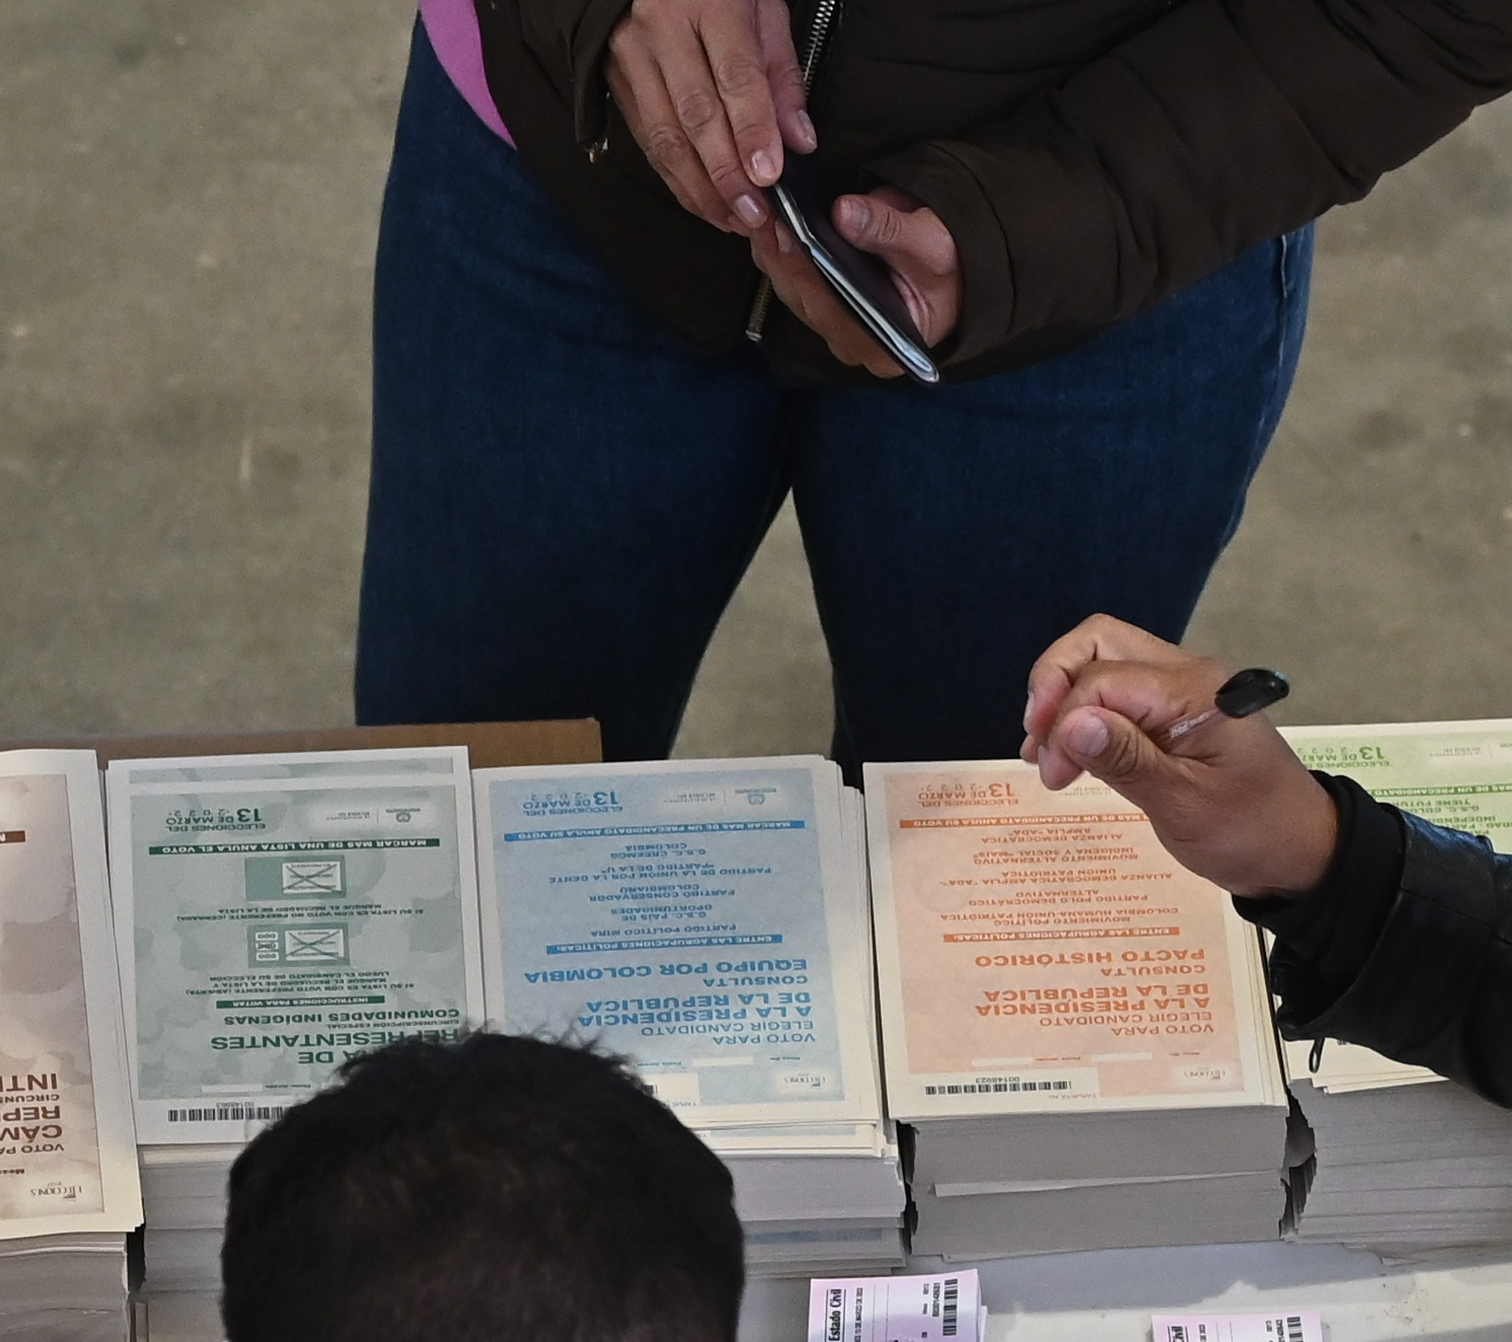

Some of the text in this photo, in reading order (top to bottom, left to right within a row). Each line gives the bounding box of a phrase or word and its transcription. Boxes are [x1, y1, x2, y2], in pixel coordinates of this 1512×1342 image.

[1357, 747, 1385, 760] 13
[989, 783, 1014, 798] 13
[594, 792, 618, 806] 13
[237, 809, 262, 823] 13
[975, 949, 1205, 967] PACTO HISTÓRICO
[525, 959, 807, 983] EQUIPO POR COLOMBIA
[1101, 966, 1206, 976] CONSULTA
[703, 976, 808, 987] CONSULTA
[984, 984, 1209, 1002] DE LA REPÚBLICA
[586, 993, 810, 1013] DE LA REPÚBLICA
[976, 998, 1210, 1017] A LA PRESIDENCIA
[225, 1010, 460, 1026] COMUNIDADES INDÍGENAS
[575, 1007, 811, 1027] A LA PRESIDENCIA
[1040, 1012, 1212, 1027] ELEGIR CANDIDATO
[639, 1021, 814, 1037] ELEGIR CANDIDATO
[1111, 1024, 1214, 1036] VOTO PARA
[713, 1034, 816, 1045] VOTO PARA
[299, 1052, 334, 1064] DE
[21, 1144, 64, 1154] VOTO
[829, 1289, 842, 1307] Civil
[829, 1311, 840, 1341] Estado
